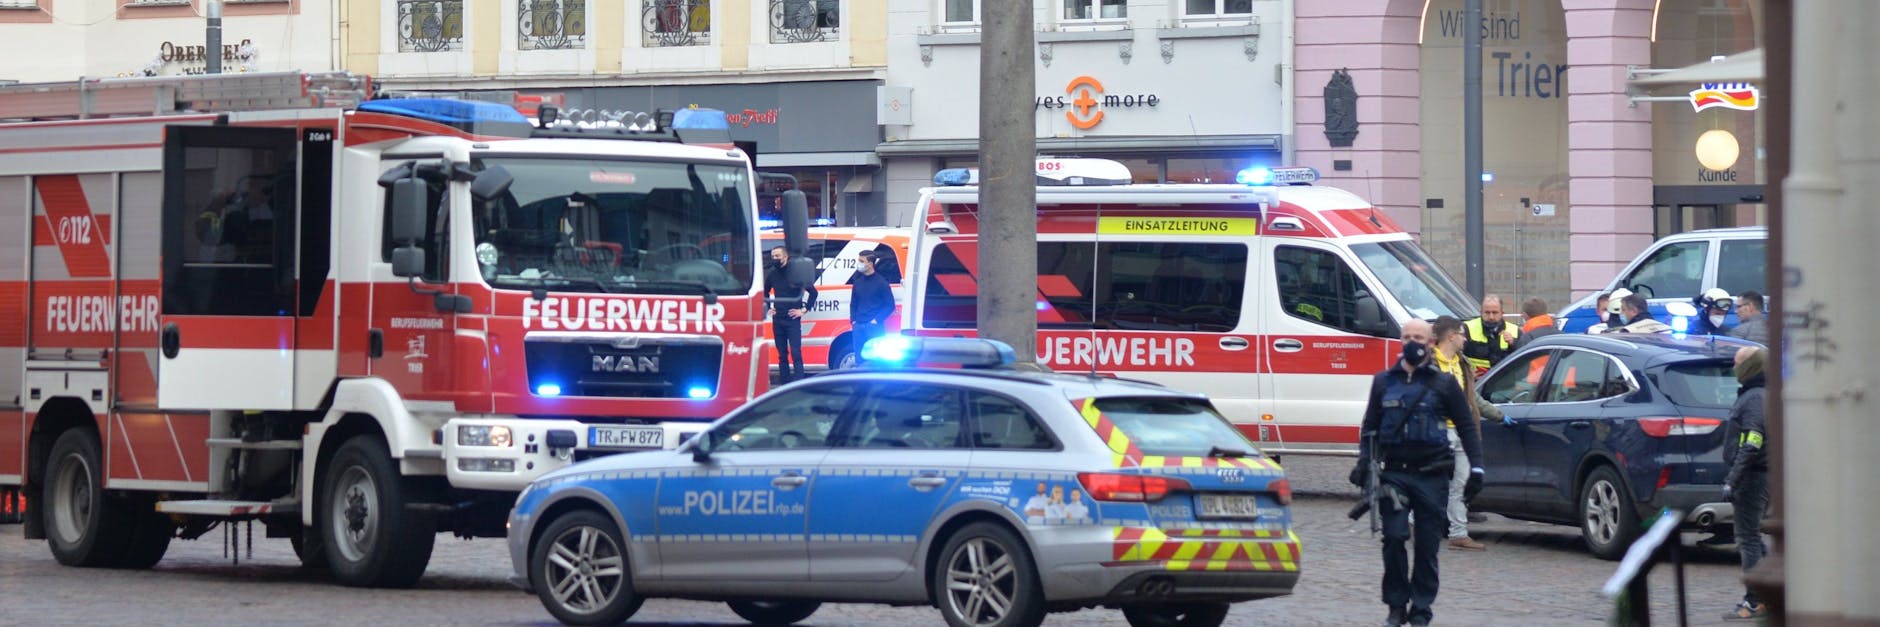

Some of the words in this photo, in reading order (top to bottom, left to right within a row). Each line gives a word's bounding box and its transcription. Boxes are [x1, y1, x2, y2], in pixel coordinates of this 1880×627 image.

[1439, 9, 1464, 38] Wi
[1480, 11, 1520, 40] sind
[161, 39, 251, 62] OBEREIS
[1491, 51, 1568, 99] Trier
[1104, 94, 1157, 108] more
[1698, 168, 1738, 182] Kunde
[70, 215, 91, 244] 112
[1125, 220, 1229, 232] EINSATZLEITUNG
[843, 258, 857, 269] 112
[46, 295, 159, 333] FEUERWEHR
[522, 297, 726, 333] FEUERWEHR
[592, 355, 660, 373] MAN
[597, 430, 613, 443] TR
[620, 430, 637, 444] FW
[639, 431, 661, 445] 877
[658, 489, 805, 516] www.POLIZEI.rlp.de
